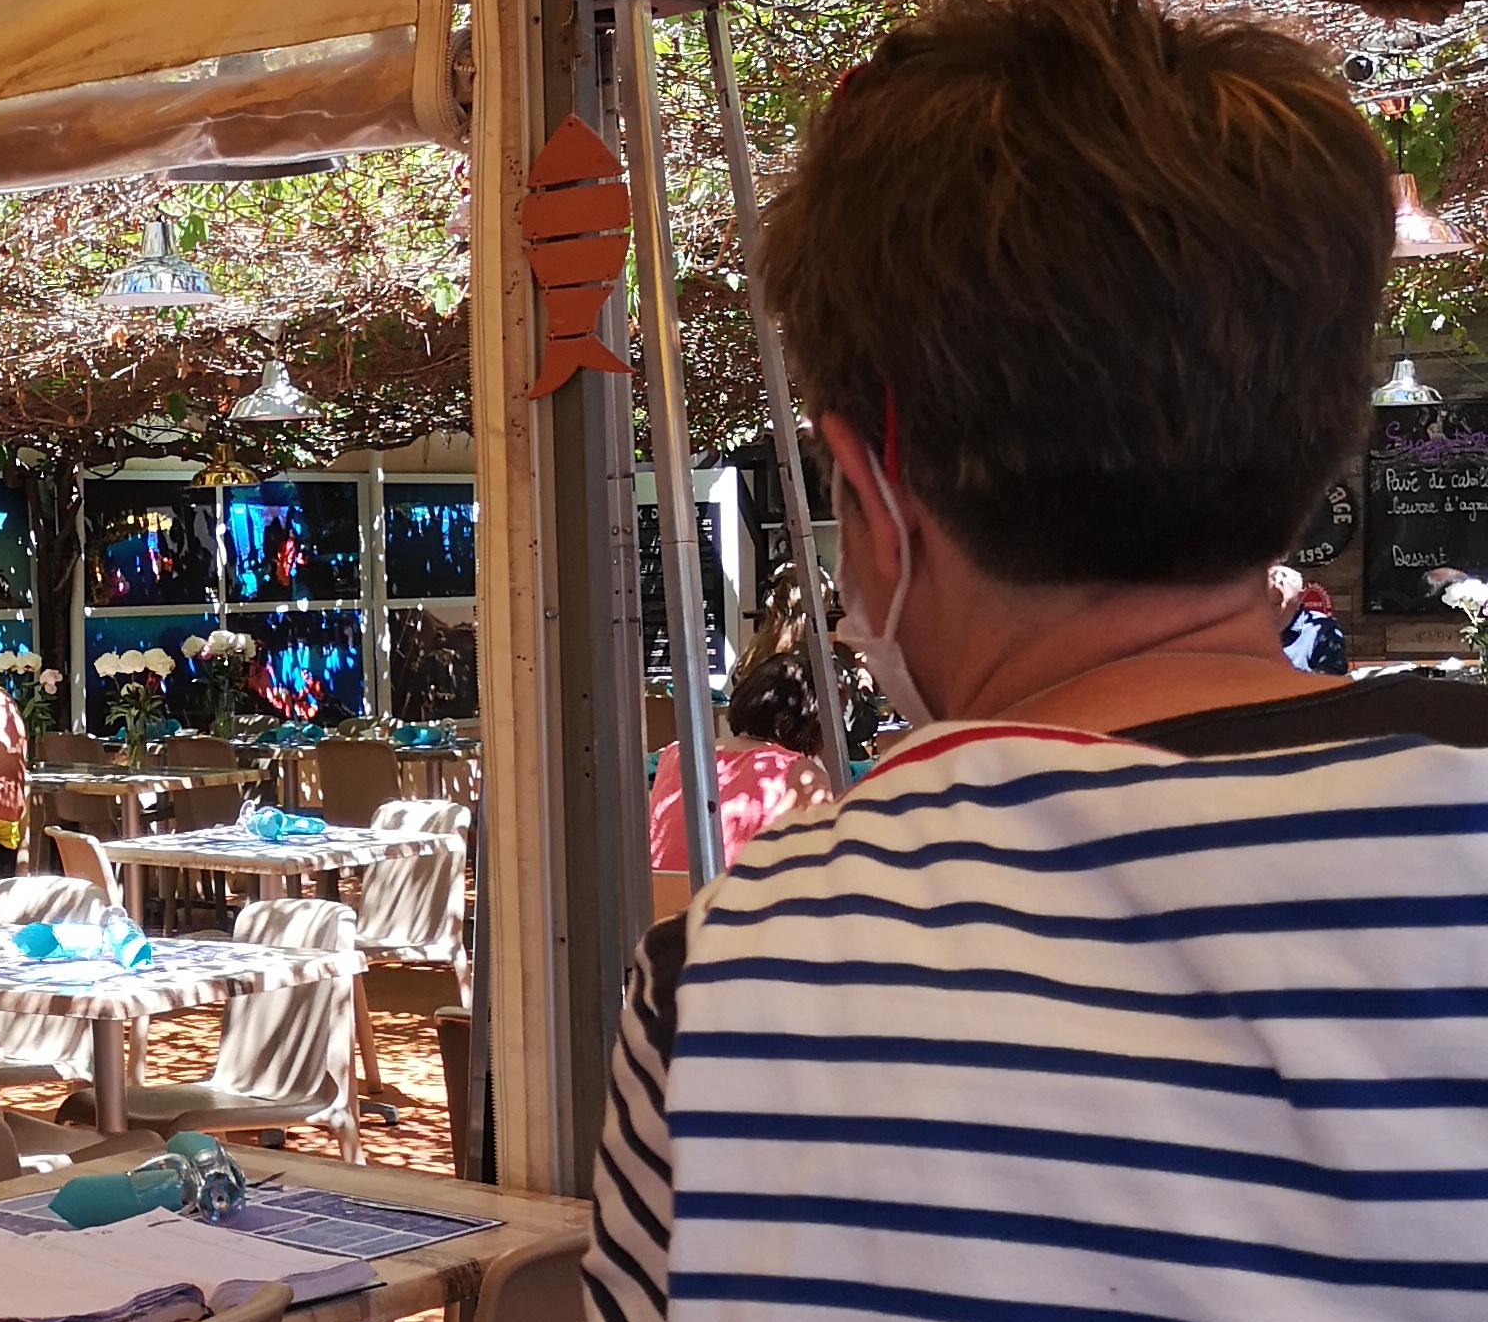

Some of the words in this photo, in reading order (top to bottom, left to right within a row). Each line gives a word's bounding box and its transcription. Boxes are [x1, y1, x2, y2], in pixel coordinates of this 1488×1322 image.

[1386, 468, 1421, 492] Pavé
[1429, 473, 1446, 489] de
[1325, 485, 1353, 525] AGE
[1297, 541, 1334, 563] 1993
[1392, 544, 1448, 567] Dessert
